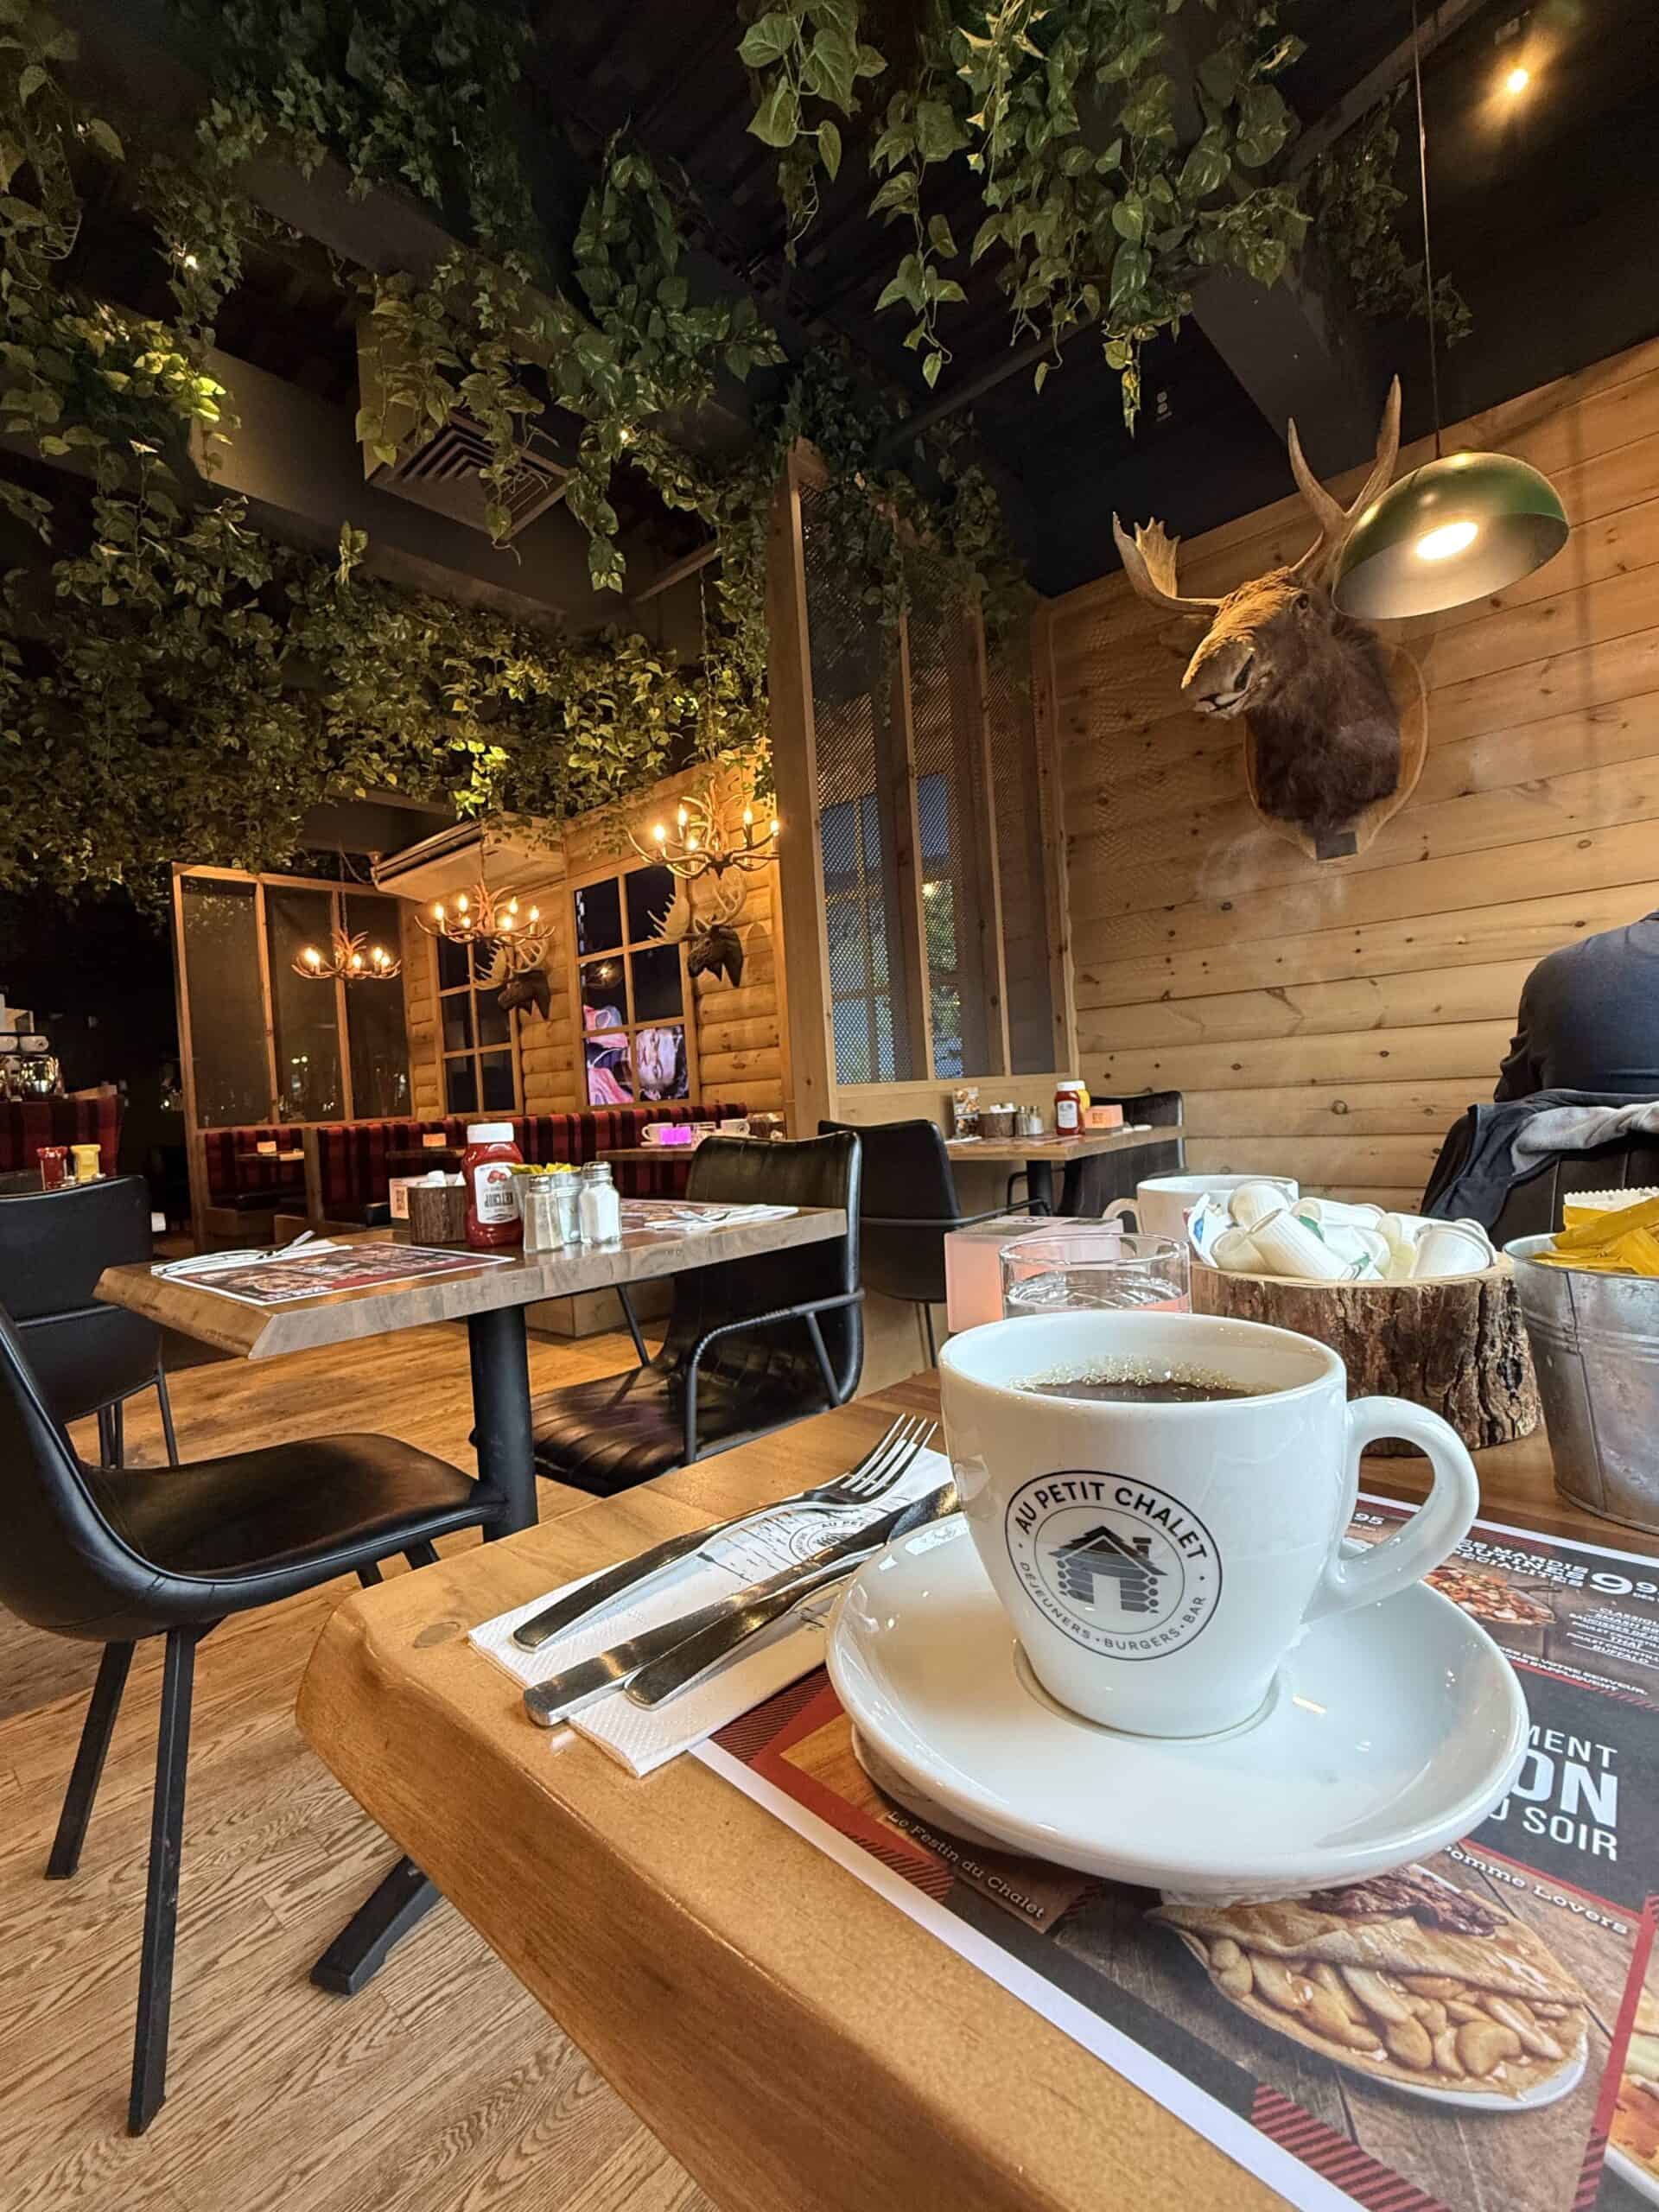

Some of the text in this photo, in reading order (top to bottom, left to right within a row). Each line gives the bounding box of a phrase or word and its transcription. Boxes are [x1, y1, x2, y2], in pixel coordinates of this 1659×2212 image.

[1015, 1481, 1207, 1560] AU PETIT CHALET
[1458, 1545, 1586, 1580] OUTINES
[1493, 1546, 1589, 1575] MARDIS
[1104, 1597, 1206, 1650] BURGERS BAR
[1523, 1807, 1618, 1861] SOIR
[912, 1825, 959, 1862] Festin
[962, 1859, 984, 1878] du
[988, 1877, 1046, 1919] Chalet
[1444, 1846, 1628, 1935] omme Lovers
